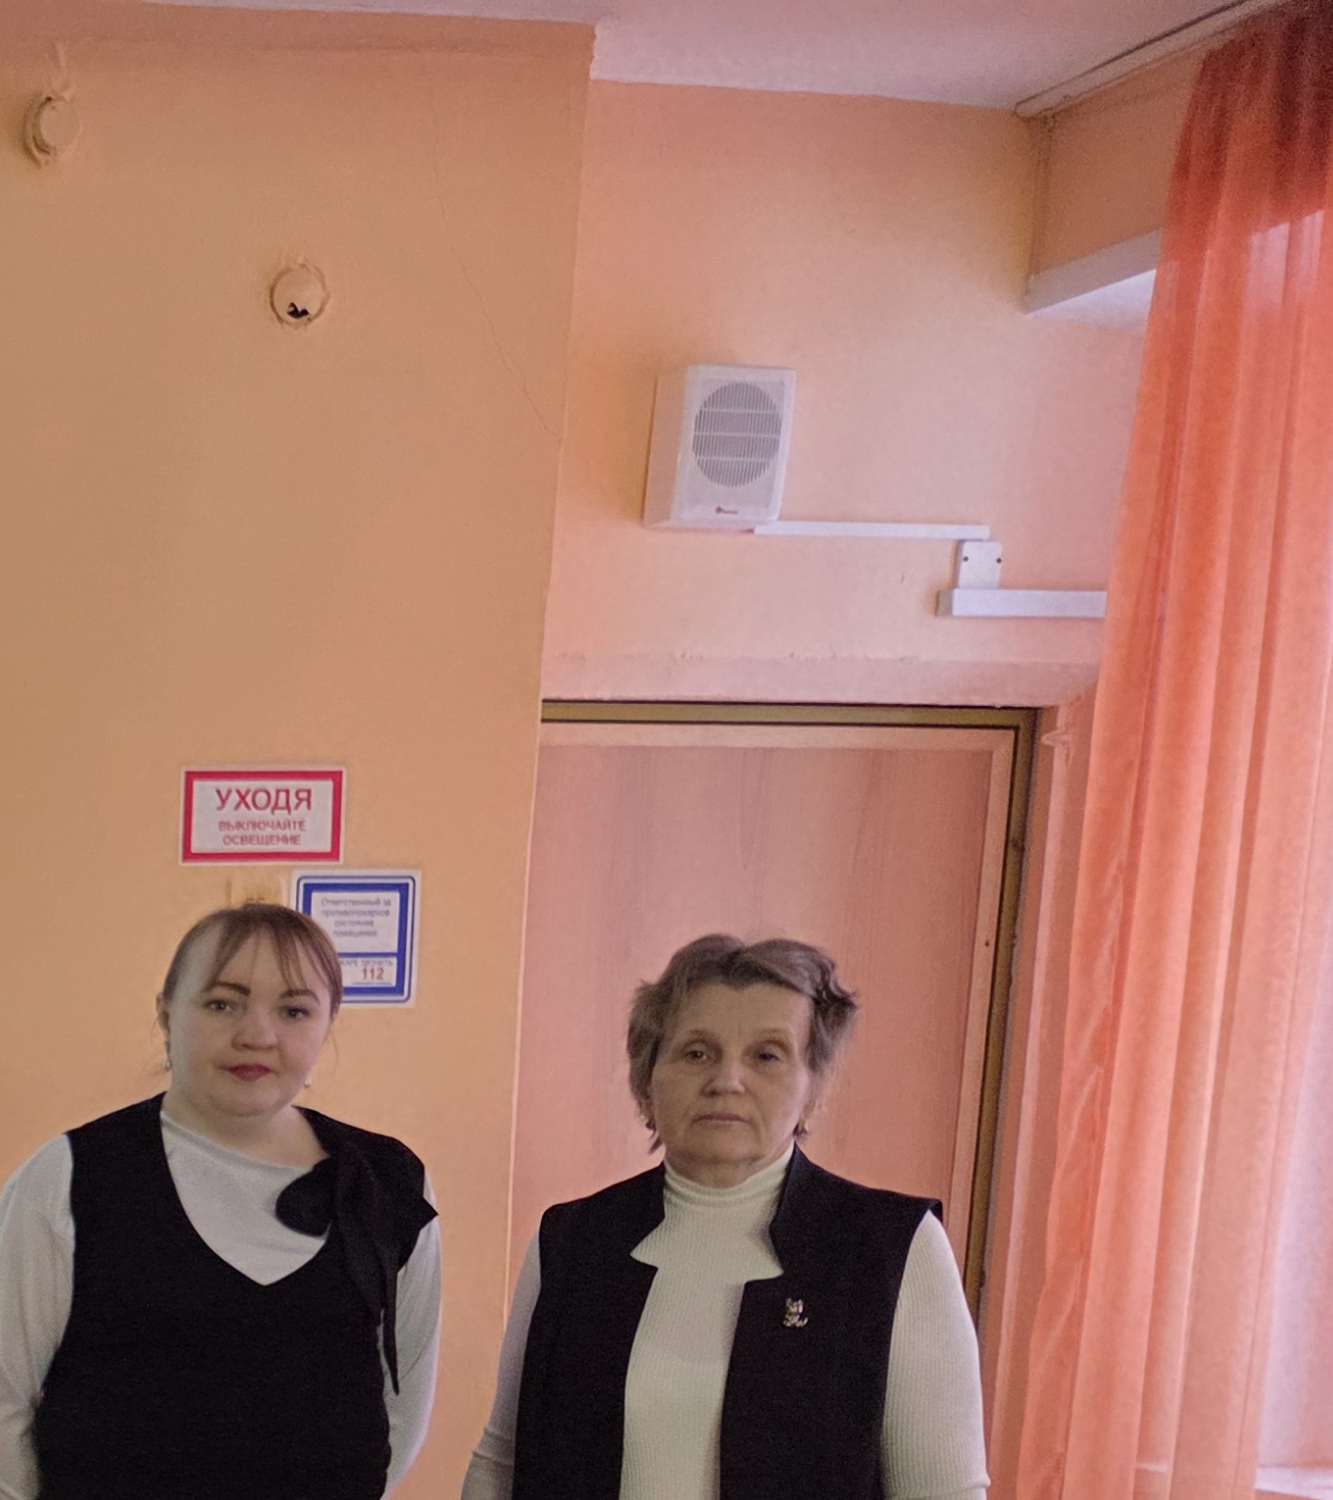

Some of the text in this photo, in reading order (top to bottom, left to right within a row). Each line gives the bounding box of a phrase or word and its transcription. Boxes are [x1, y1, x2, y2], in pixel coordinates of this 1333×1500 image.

[215, 788, 313, 815] УХОДЯ
[218, 819, 307, 832] ВЫКЛЮЧАЙТЕ
[222, 834, 302, 846] ОСВЕЩЕНИЕ
[362, 966, 385, 980] 112
